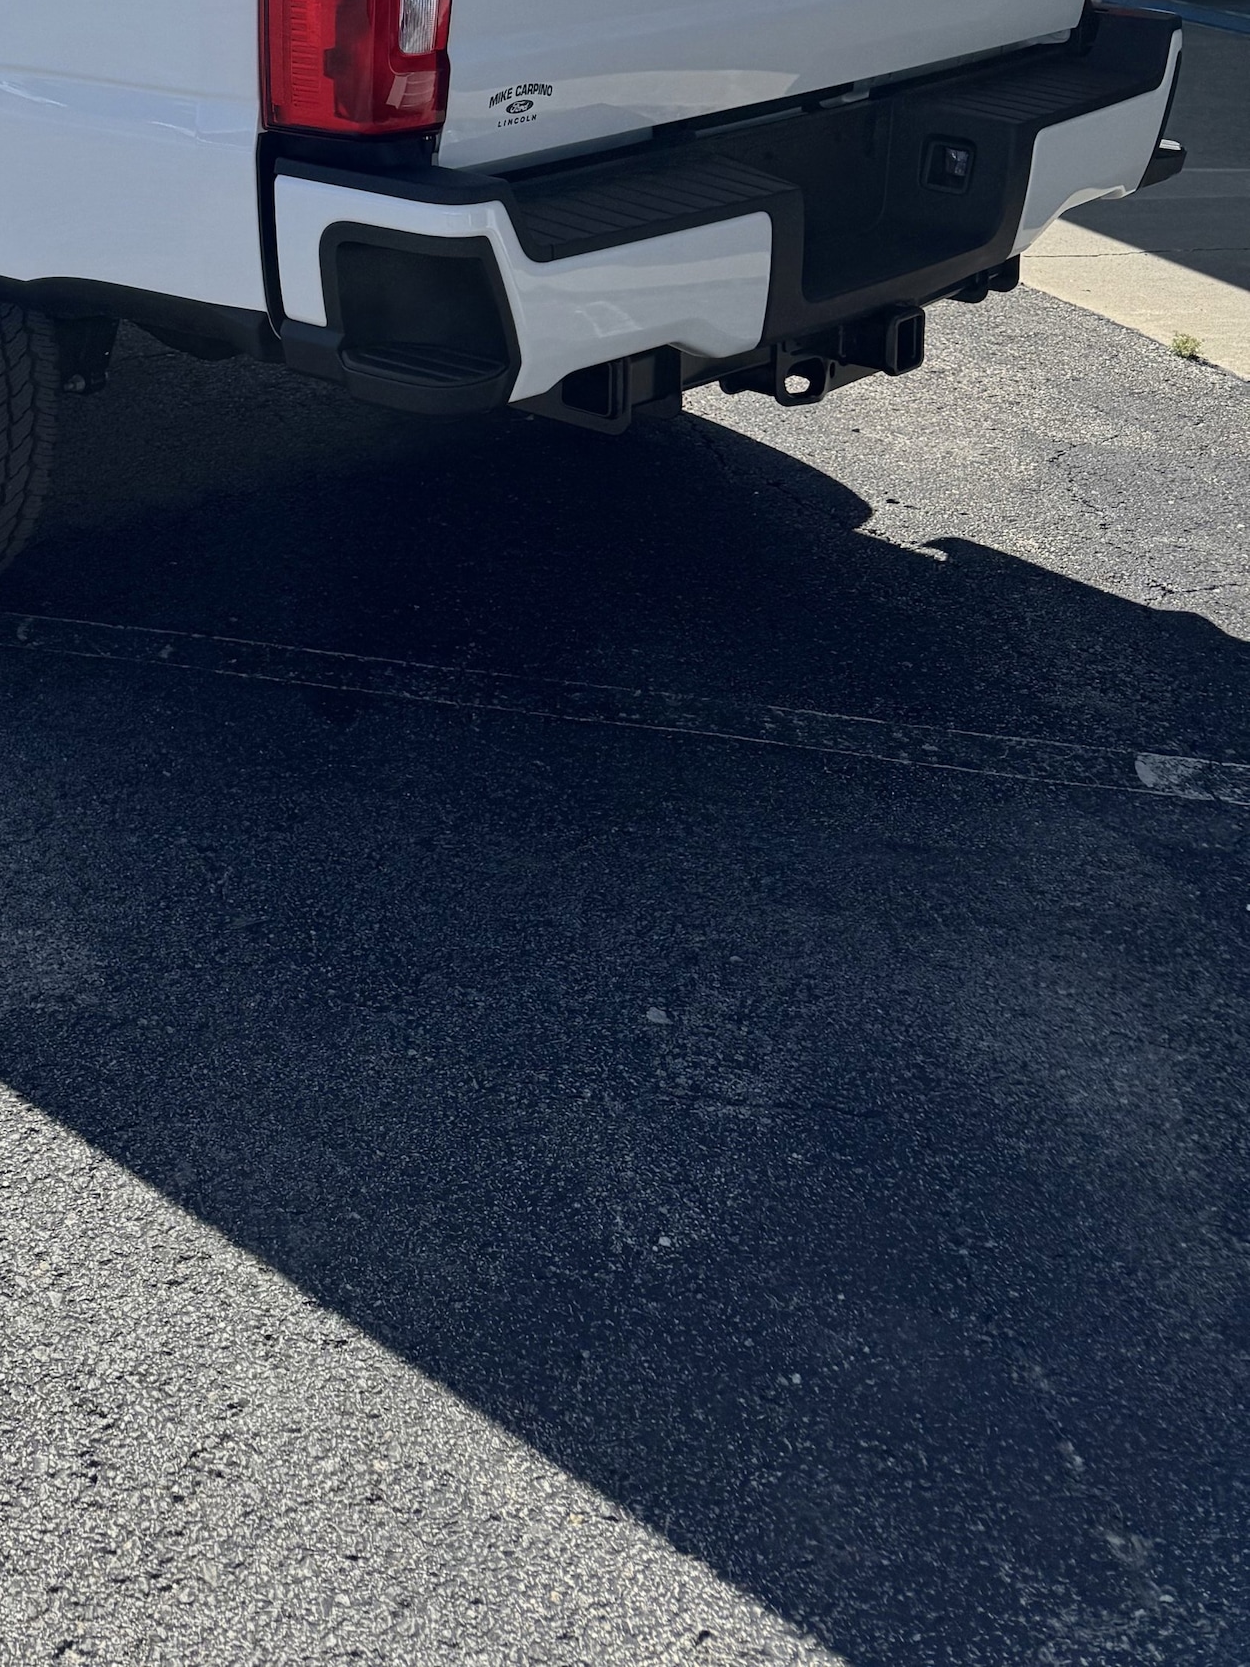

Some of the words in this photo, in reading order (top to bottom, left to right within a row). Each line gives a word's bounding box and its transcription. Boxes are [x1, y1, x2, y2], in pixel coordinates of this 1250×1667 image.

[488, 87, 514, 109] MIKE
[515, 83, 553, 97] CARPINO
[497, 114, 537, 128] LINCOLN
